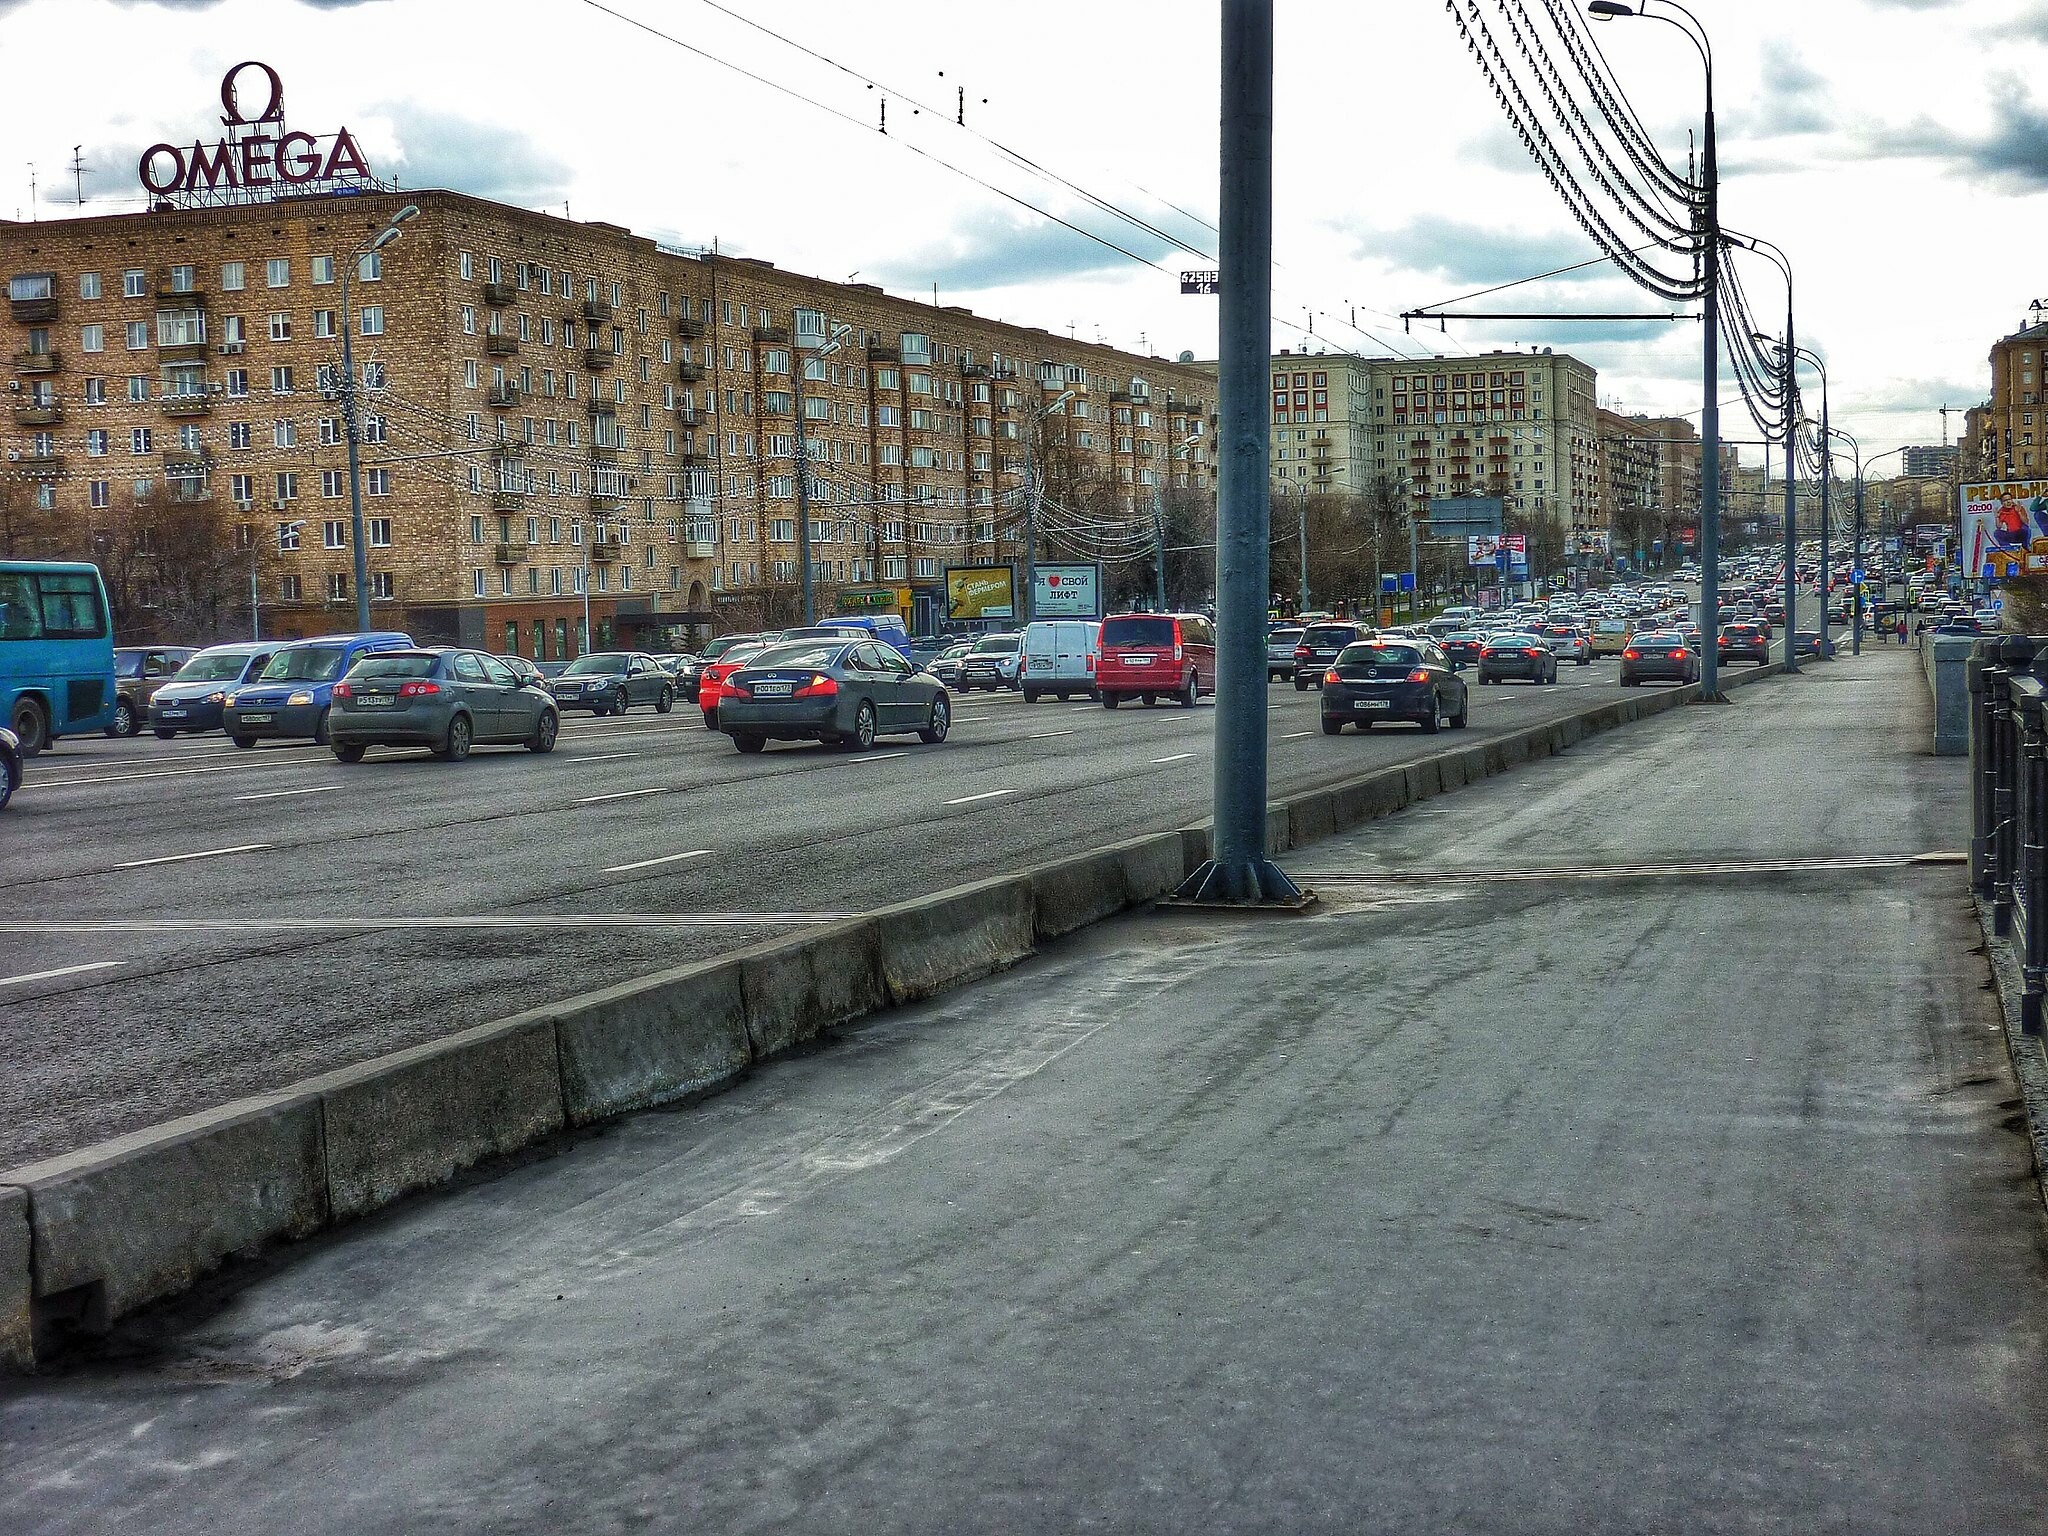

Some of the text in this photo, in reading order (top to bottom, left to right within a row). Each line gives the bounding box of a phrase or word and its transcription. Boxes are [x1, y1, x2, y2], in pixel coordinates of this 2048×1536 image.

[138, 126, 370, 196] OMEGA
[1196, 282, 1211, 294] 16
[1967, 503, 1993, 513] 20:00
[966, 579, 989, 591] СТАНЬ
[1038, 574, 1089, 586] Я СВОЙ
[968, 580, 1007, 597] ФЕРМЕРОМ
[1049, 590, 1078, 600] ЛИФТ
